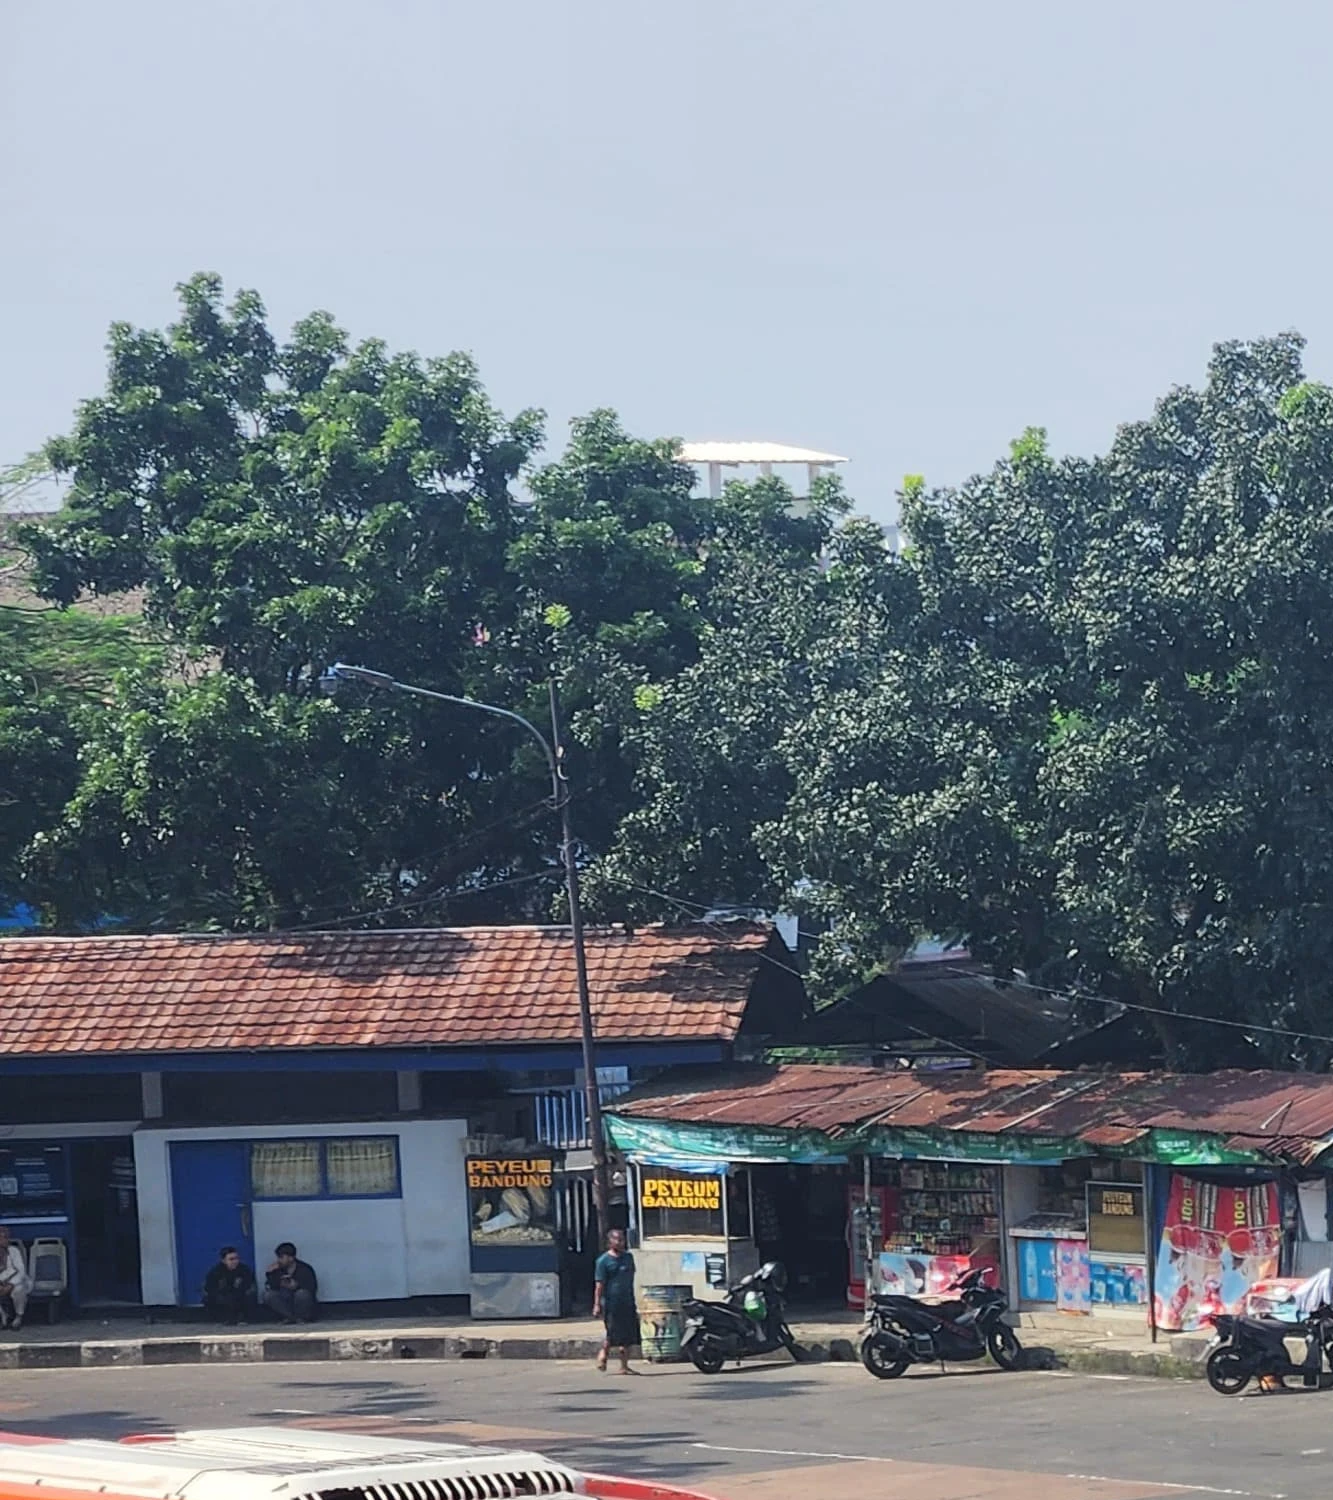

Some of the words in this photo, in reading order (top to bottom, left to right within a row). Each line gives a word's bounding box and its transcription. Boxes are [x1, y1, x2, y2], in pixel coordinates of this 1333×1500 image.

[469, 1174, 552, 1188] BANDUNG
[644, 1179, 720, 1197] PEYEUM
[642, 1196, 720, 1209] BANDUNG
